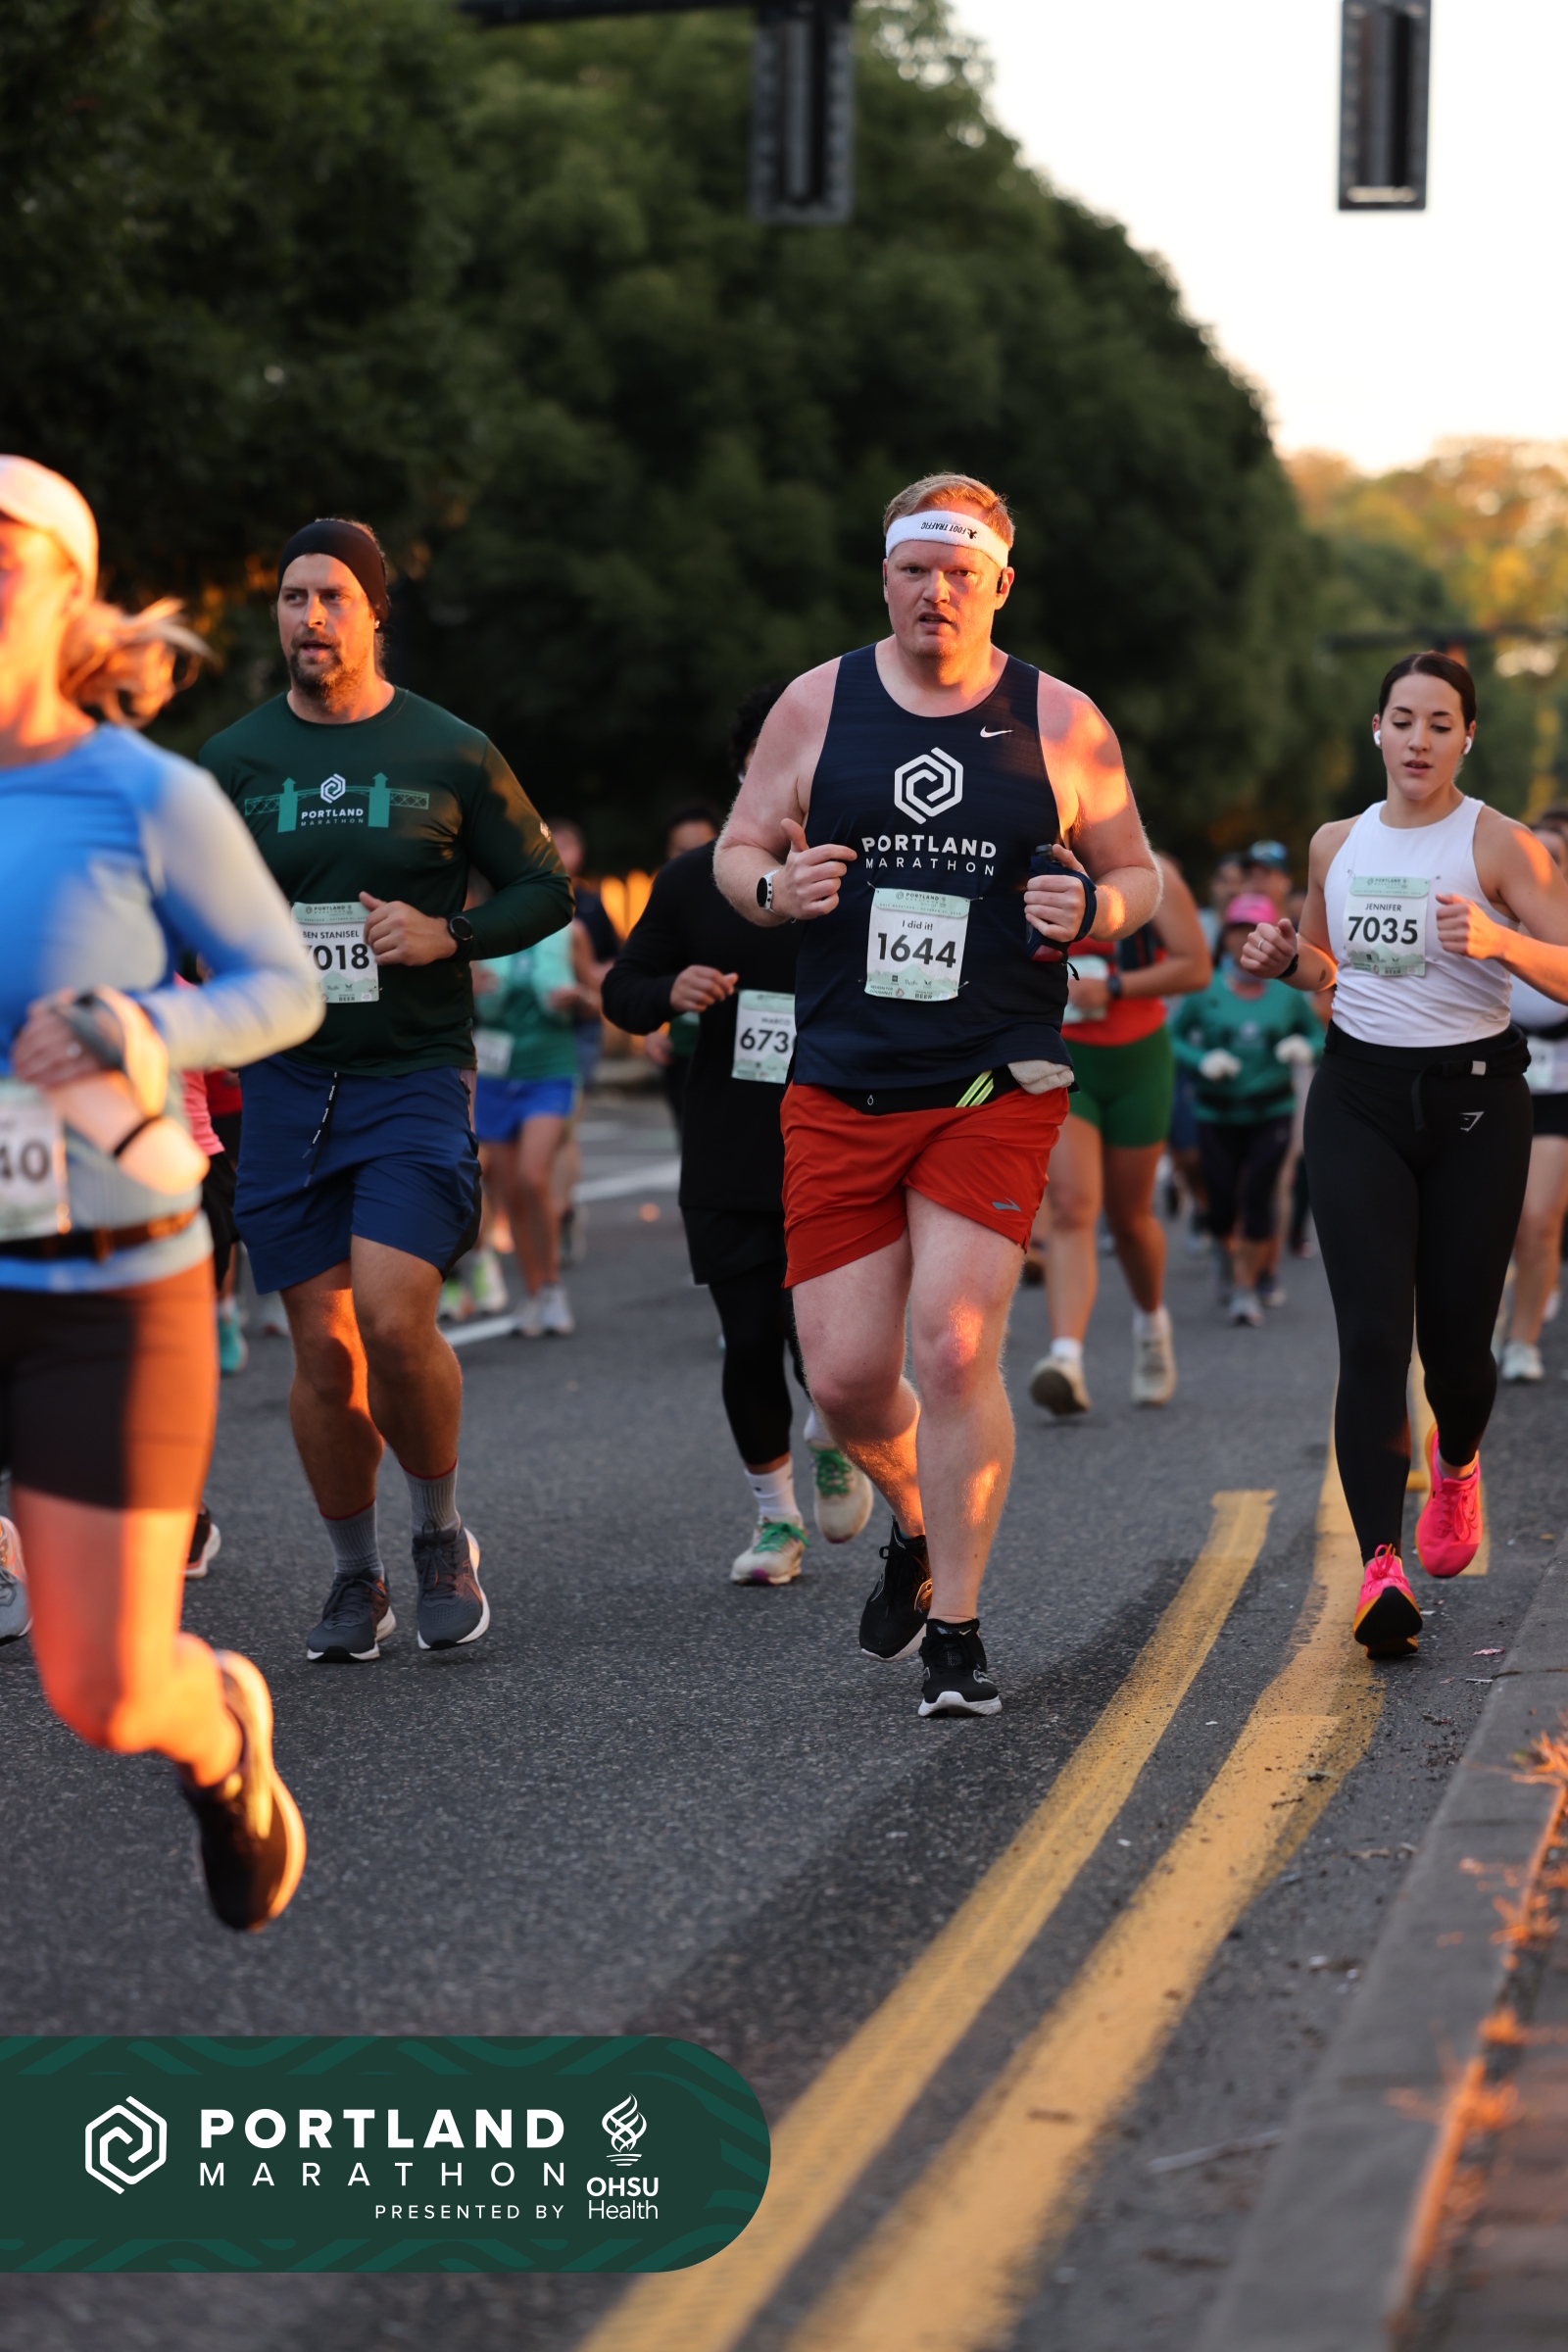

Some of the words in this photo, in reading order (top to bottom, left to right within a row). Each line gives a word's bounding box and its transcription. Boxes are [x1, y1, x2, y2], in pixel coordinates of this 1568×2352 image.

[921, 521, 949, 531] TRAFFIC
[949, 524, 967, 535] FOOT
[301, 808, 364, 820] PORTLAND
[301, 818, 364, 827] MARATHON
[861, 834, 997, 858] PORTLAND
[865, 858, 995, 876] MARATHON
[906, 892, 940, 901] PORTLAND
[1365, 903, 1402, 912] JENNIFER
[907, 920, 922, 930] did
[924, 922, 934, 931] it!
[1348, 916, 1418, 945] 7035
[302, 930, 318, 939] BEN
[320, 930, 360, 939] STANISEL
[877, 932, 956, 968] 1644
[740, 1027, 795, 1054] 673
